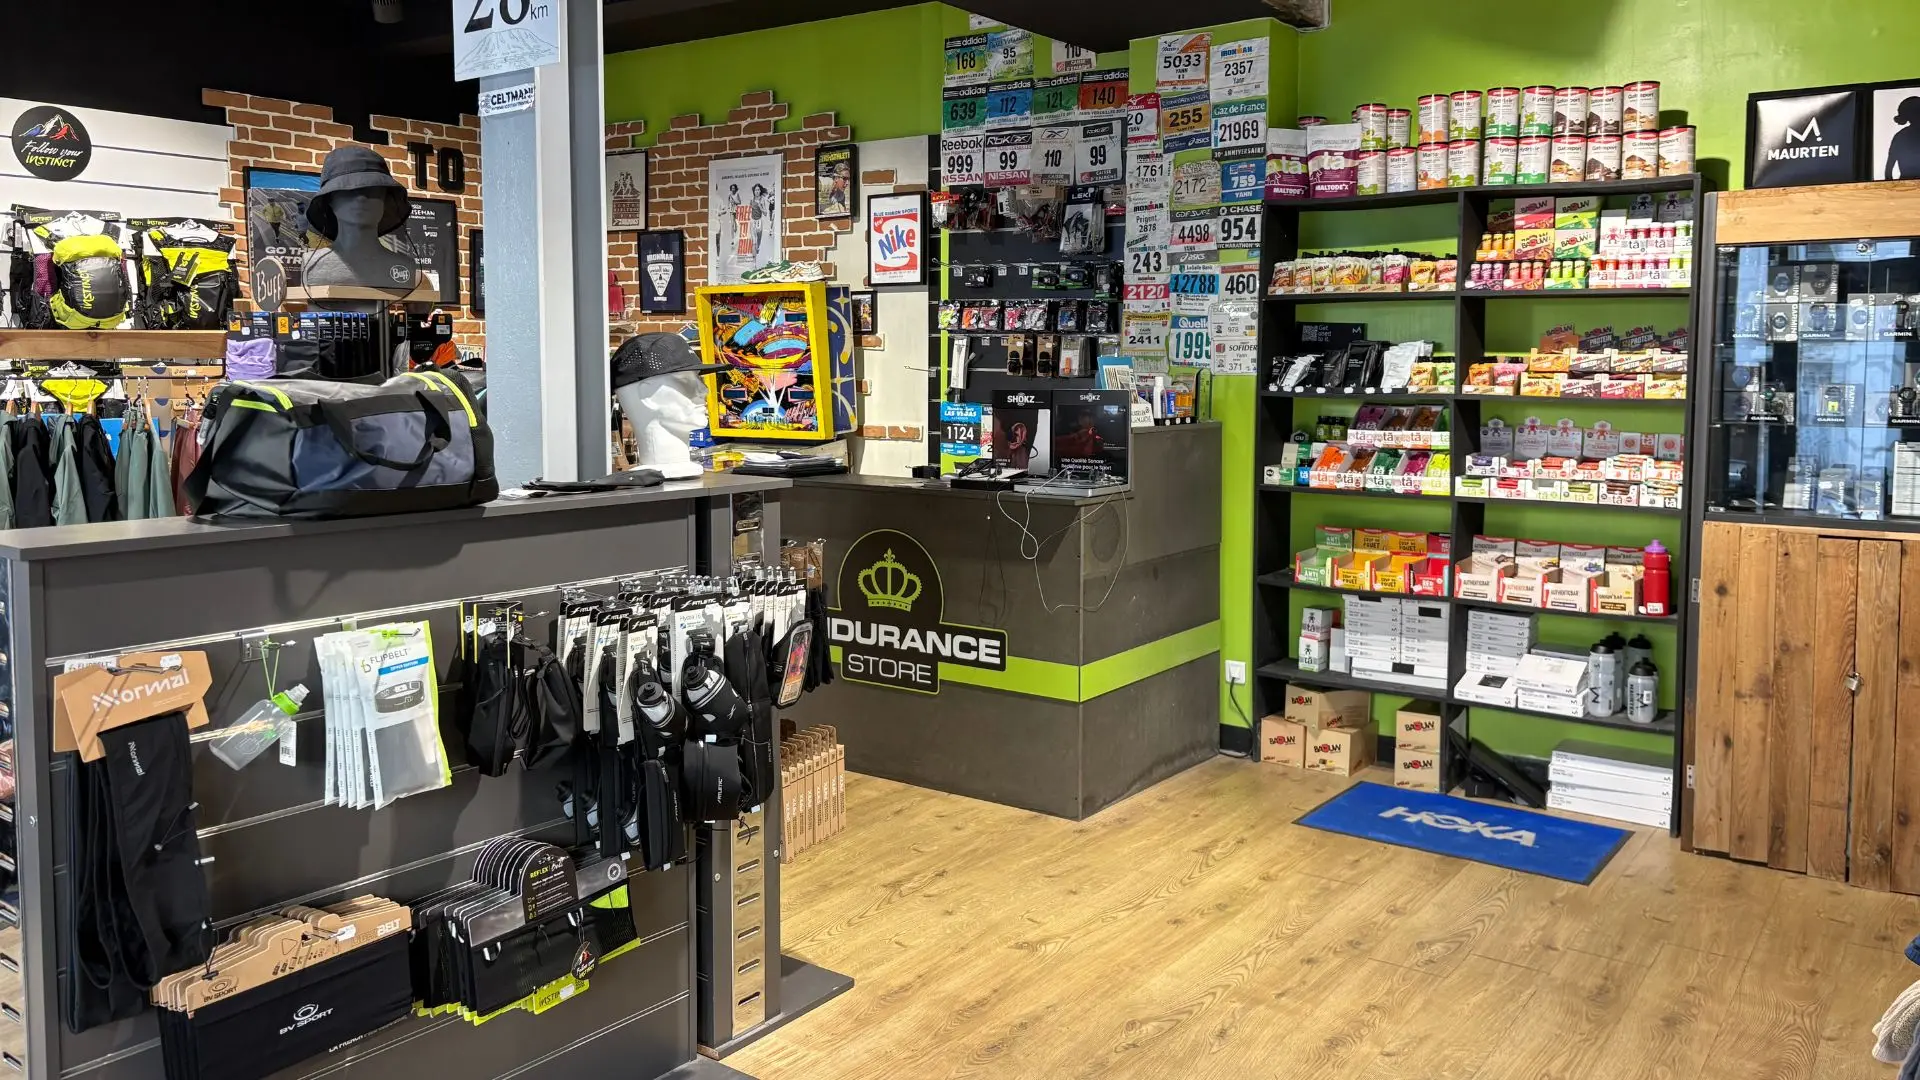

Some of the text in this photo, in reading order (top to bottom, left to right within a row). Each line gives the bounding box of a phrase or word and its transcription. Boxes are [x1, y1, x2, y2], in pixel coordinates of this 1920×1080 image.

[530, 4, 549, 20] km
[962, 36, 987, 46] adidas
[956, 50, 976, 70] 168
[1003, 46, 1016, 59] 95
[1163, 54, 1202, 69] 5033
[1224, 60, 1254, 77] 2357
[1050, 75, 1078, 87] adidas
[1103, 71, 1128, 80] adidas
[959, 87, 986, 97] adidas
[1007, 81, 1031, 90] adidas
[1046, 91, 1064, 109] 121
[1093, 86, 1116, 105] 140
[951, 101, 977, 120] 639
[1000, 96, 1017, 113] 112
[1214, 101, 1266, 116] Gaz de France
[1169, 108, 1203, 127] 255
[1219, 120, 1259, 143] 21969
[20, 139, 84, 159] Follow your
[942, 137, 983, 152] Reebok
[1000, 150, 1018, 170] 99
[1044, 149, 1062, 167] 110
[1090, 144, 1107, 166] 99
[1768, 145, 1839, 161] MAURTEN
[408, 141, 465, 193] TO
[947, 154, 974, 174] 999
[1136, 164, 1164, 177] 1761
[988, 170, 1028, 180] NISSAN
[1231, 174, 1256, 189] 759
[1175, 178, 1207, 195] 2172
[1071, 191, 1092, 199] LEKI
[735, 205, 752, 222] FREE
[1229, 205, 1262, 213] CHASE
[1520, 200, 1548, 213] BAOUW
[1562, 200, 1590, 213] BAOUW
[739, 222, 749, 238] TO
[1179, 224, 1210, 243] 4498
[1221, 217, 1257, 243] 954
[265, 246, 287, 254] GO
[878, 224, 916, 261] Nike
[1132, 252, 1162, 274] 243
[392, 268, 409, 281] Buff
[257, 270, 282, 304] Buff
[1127, 285, 1165, 299] 2120
[1172, 274, 1216, 294] 12788
[1225, 273, 1257, 295] 460
[1791, 304, 1799, 335] GARMIN
[1129, 336, 1160, 345] 2411
[1590, 335, 1612, 345] PROTEIN
[1631, 335, 1654, 345] PROTEIN
[1007, 395, 1035, 403] SHOKZ
[947, 426, 974, 440] 1124
[370, 648, 409, 663] FLIPBELT
[848, 653, 932, 684] STORE
[1291, 696, 1313, 705] BAOUW
[1405, 720, 1435, 732] BAOUW
[1268, 735, 1296, 745] BAOUW
[1314, 743, 1342, 753] BAOUW
[1403, 760, 1433, 770] BAOUW
[1378, 805, 1538, 848] HOKA
[530, 867, 549, 879] REFLEX
[376, 918, 401, 937] BELT
[203, 986, 238, 1003] BV SPORT
[279, 1008, 334, 1035] BV SPORT
